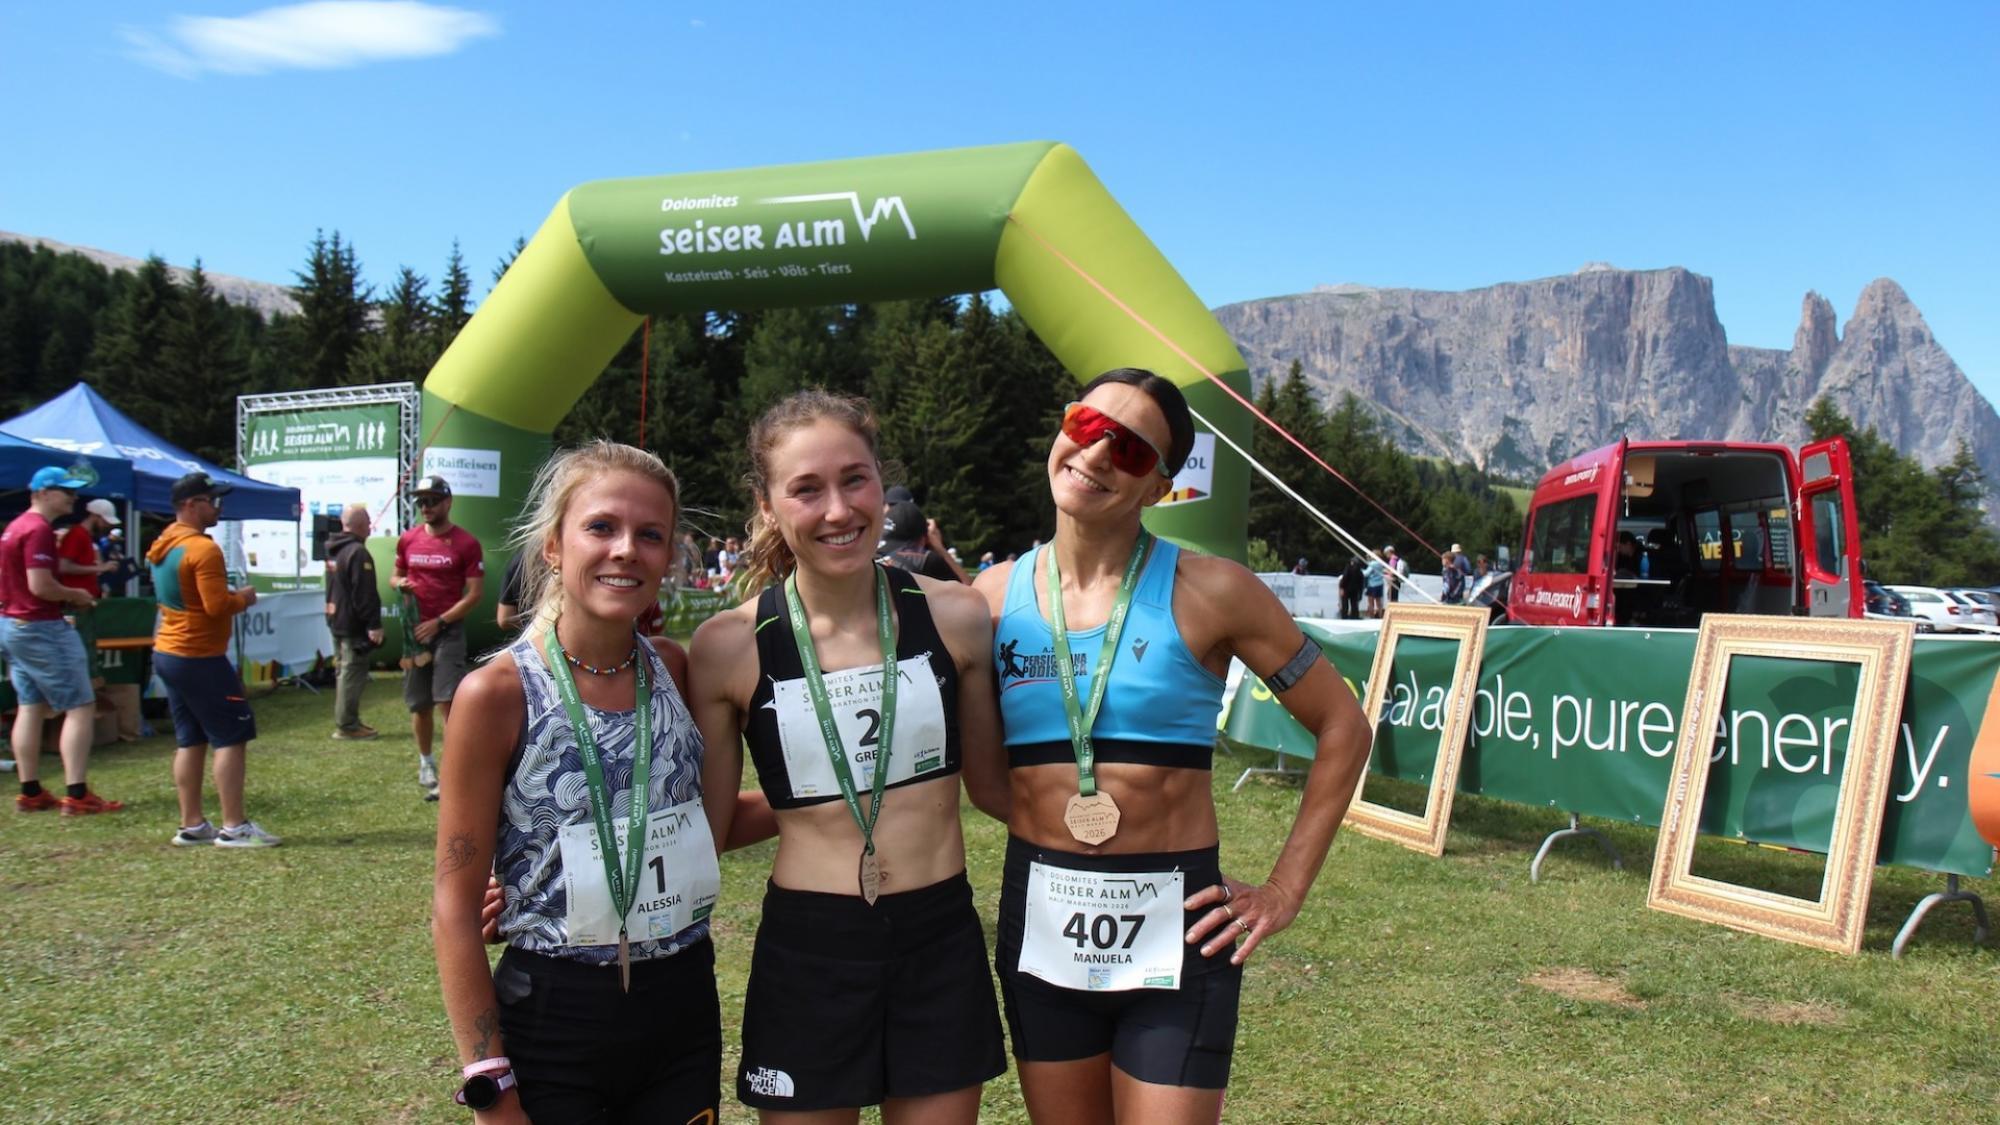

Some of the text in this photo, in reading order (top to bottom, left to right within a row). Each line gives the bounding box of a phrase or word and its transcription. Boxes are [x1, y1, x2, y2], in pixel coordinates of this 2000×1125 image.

[661, 194, 739, 212] Dolomites
[665, 262, 852, 283] Kastelruth Seis Völs Tiers
[437, 457, 497, 471] Raiffeisen
[803, 685, 854, 704] SSER
[833, 698, 869, 708] ARATHON
[1419, 673, 1540, 750] aple,
[1550, 692, 1676, 760] pure
[855, 708, 881, 748] 2
[651, 824, 676, 840] ALM
[1084, 829, 1106, 839] 2026
[648, 855, 666, 894] 1
[1050, 871, 1098, 885] DOLOMITES
[1049, 881, 1131, 899] SEISER ALM
[637, 894, 682, 915] ALESSIA
[1067, 899, 1108, 909] MARATHON
[1062, 912, 1146, 950] 407
[1073, 952, 1133, 965] MANUELA
[745, 1071, 776, 1089] NORTH
[758, 1066, 777, 1078] THE
[750, 1082, 775, 1096] FACE
